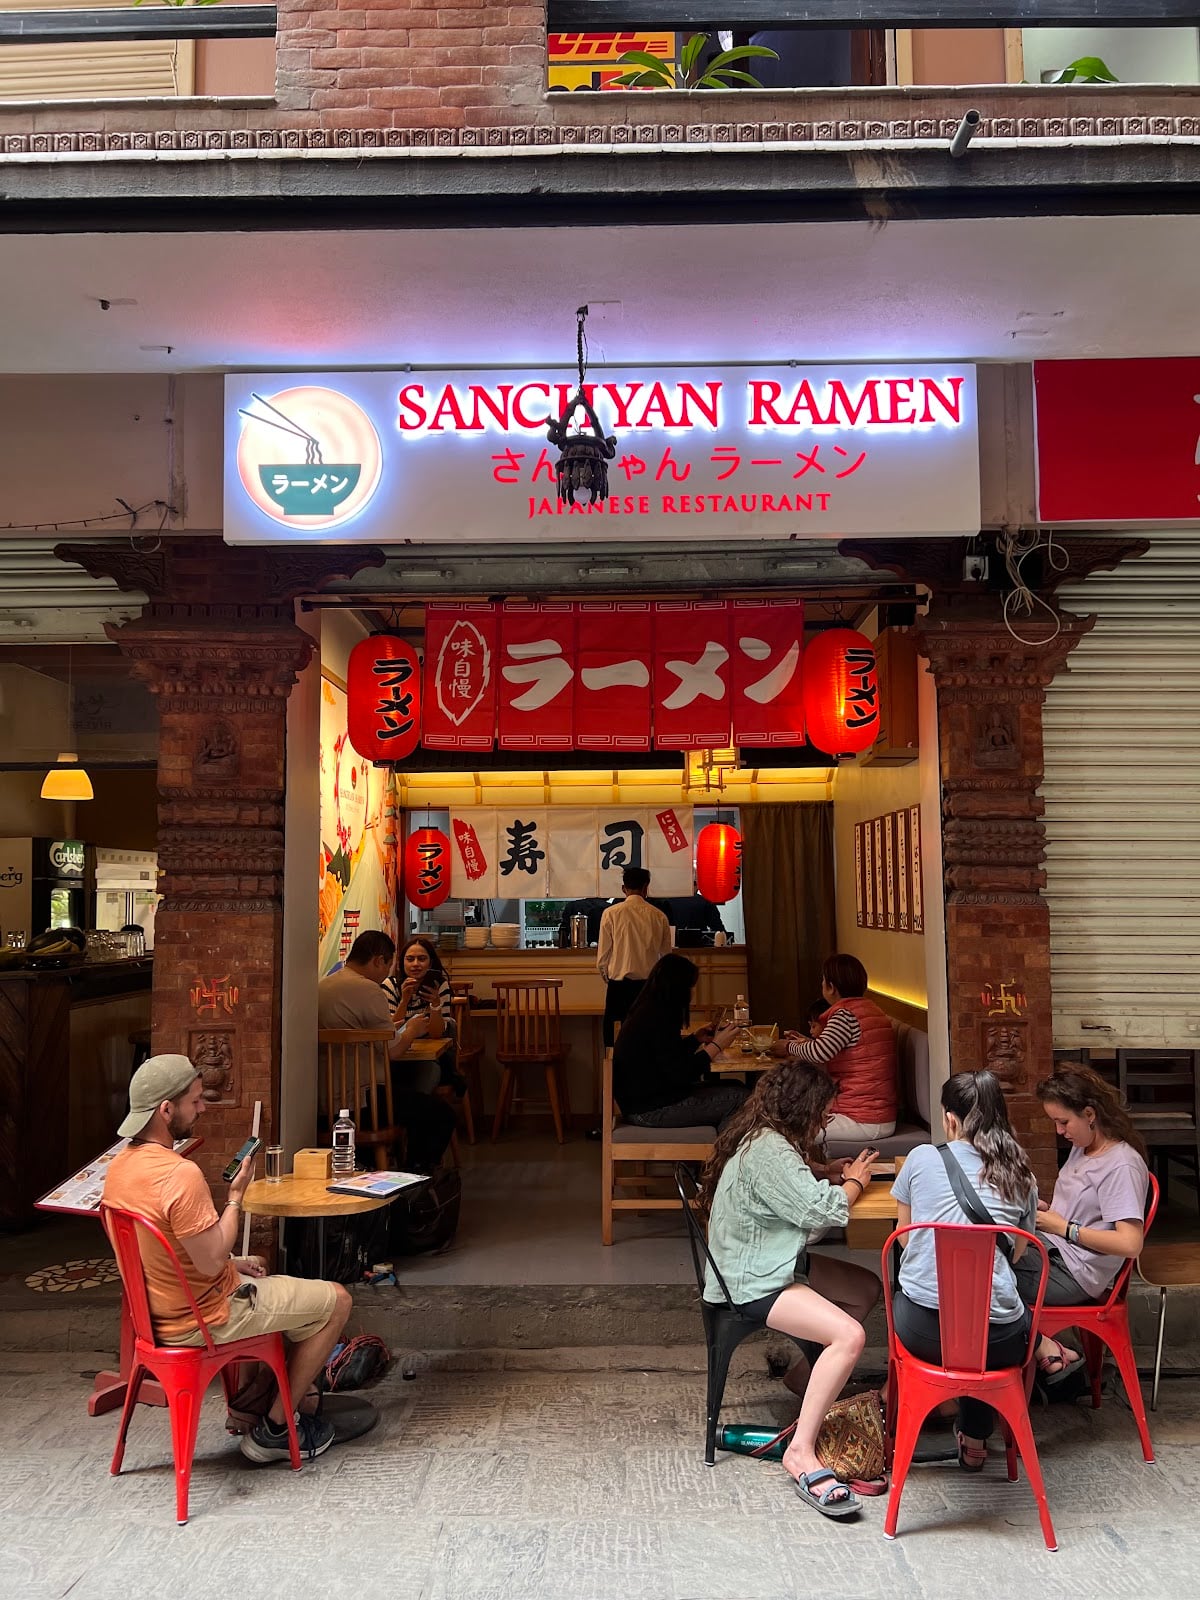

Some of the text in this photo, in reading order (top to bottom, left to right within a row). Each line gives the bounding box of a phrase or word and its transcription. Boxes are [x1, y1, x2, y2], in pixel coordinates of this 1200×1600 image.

[399, 378, 964, 431] SANCHYAN RAMEN
[272, 474, 349, 495] ラーメン
[491, 445, 866, 484] さんゃん ラーメン
[528, 493, 832, 519] JAPANESE RESTAURANT
[449, 638, 477, 699] 味自慢
[501, 636, 800, 711] ラーメン
[844, 647, 878, 729] ラーメン
[372, 658, 414, 740] ラーメン
[416, 842, 444, 895] ラーメン
[458, 832, 480, 874] 味自慢
